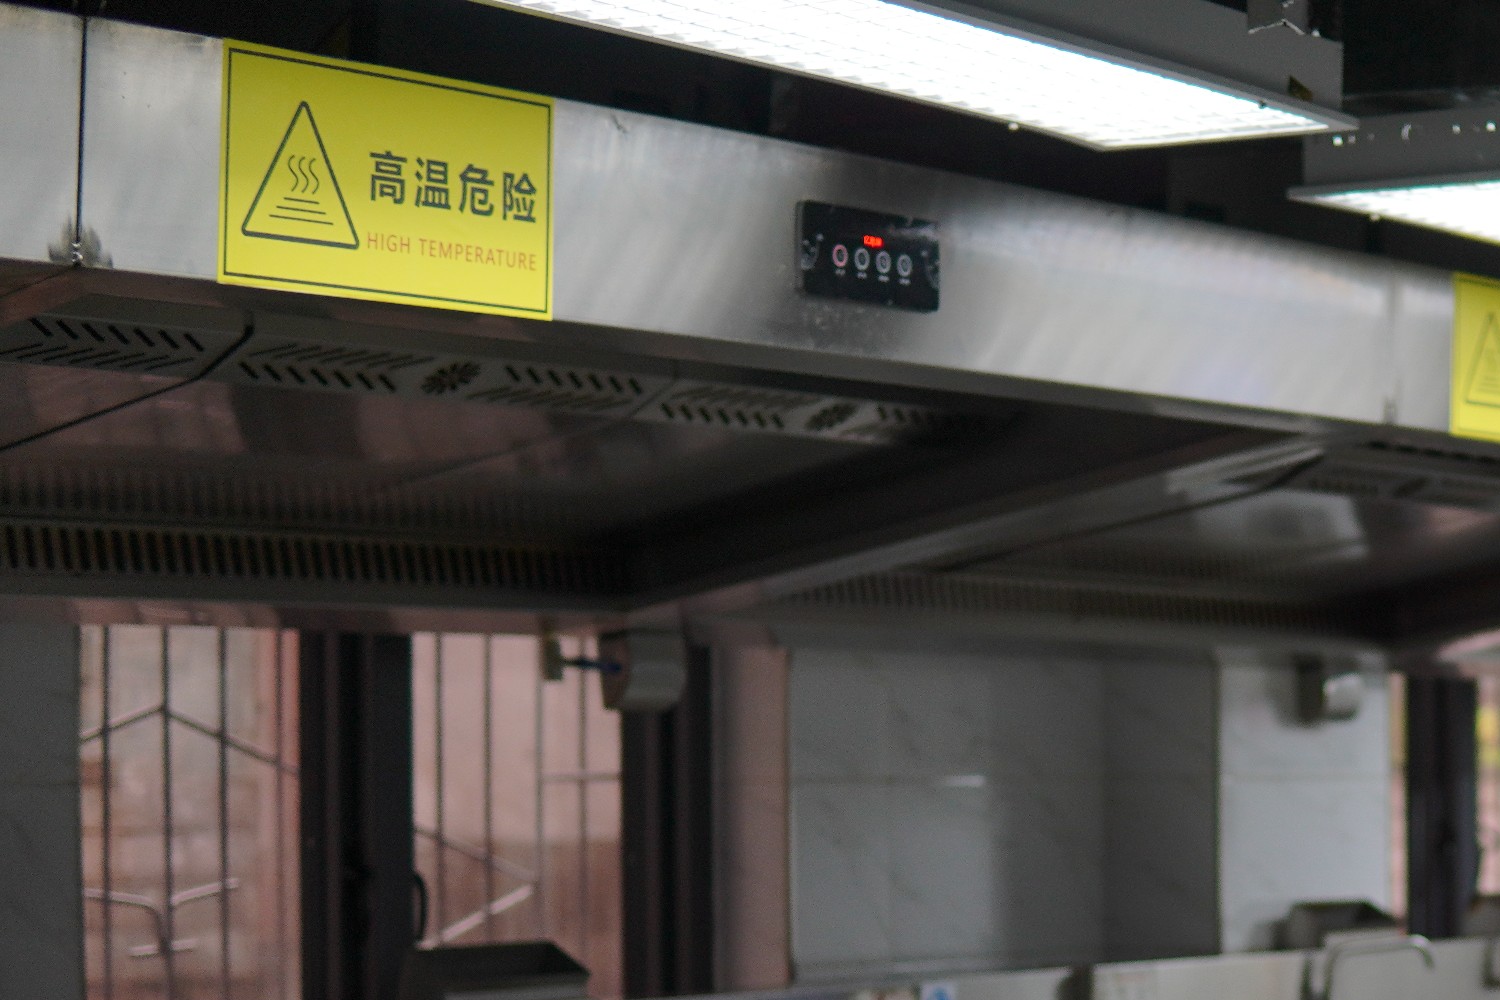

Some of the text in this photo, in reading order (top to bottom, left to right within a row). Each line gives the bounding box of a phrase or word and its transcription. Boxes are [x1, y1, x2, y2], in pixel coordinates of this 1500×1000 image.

[369, 151, 537, 224] 高温危险
[367, 232, 537, 272] HIGH TEMPERATURE
